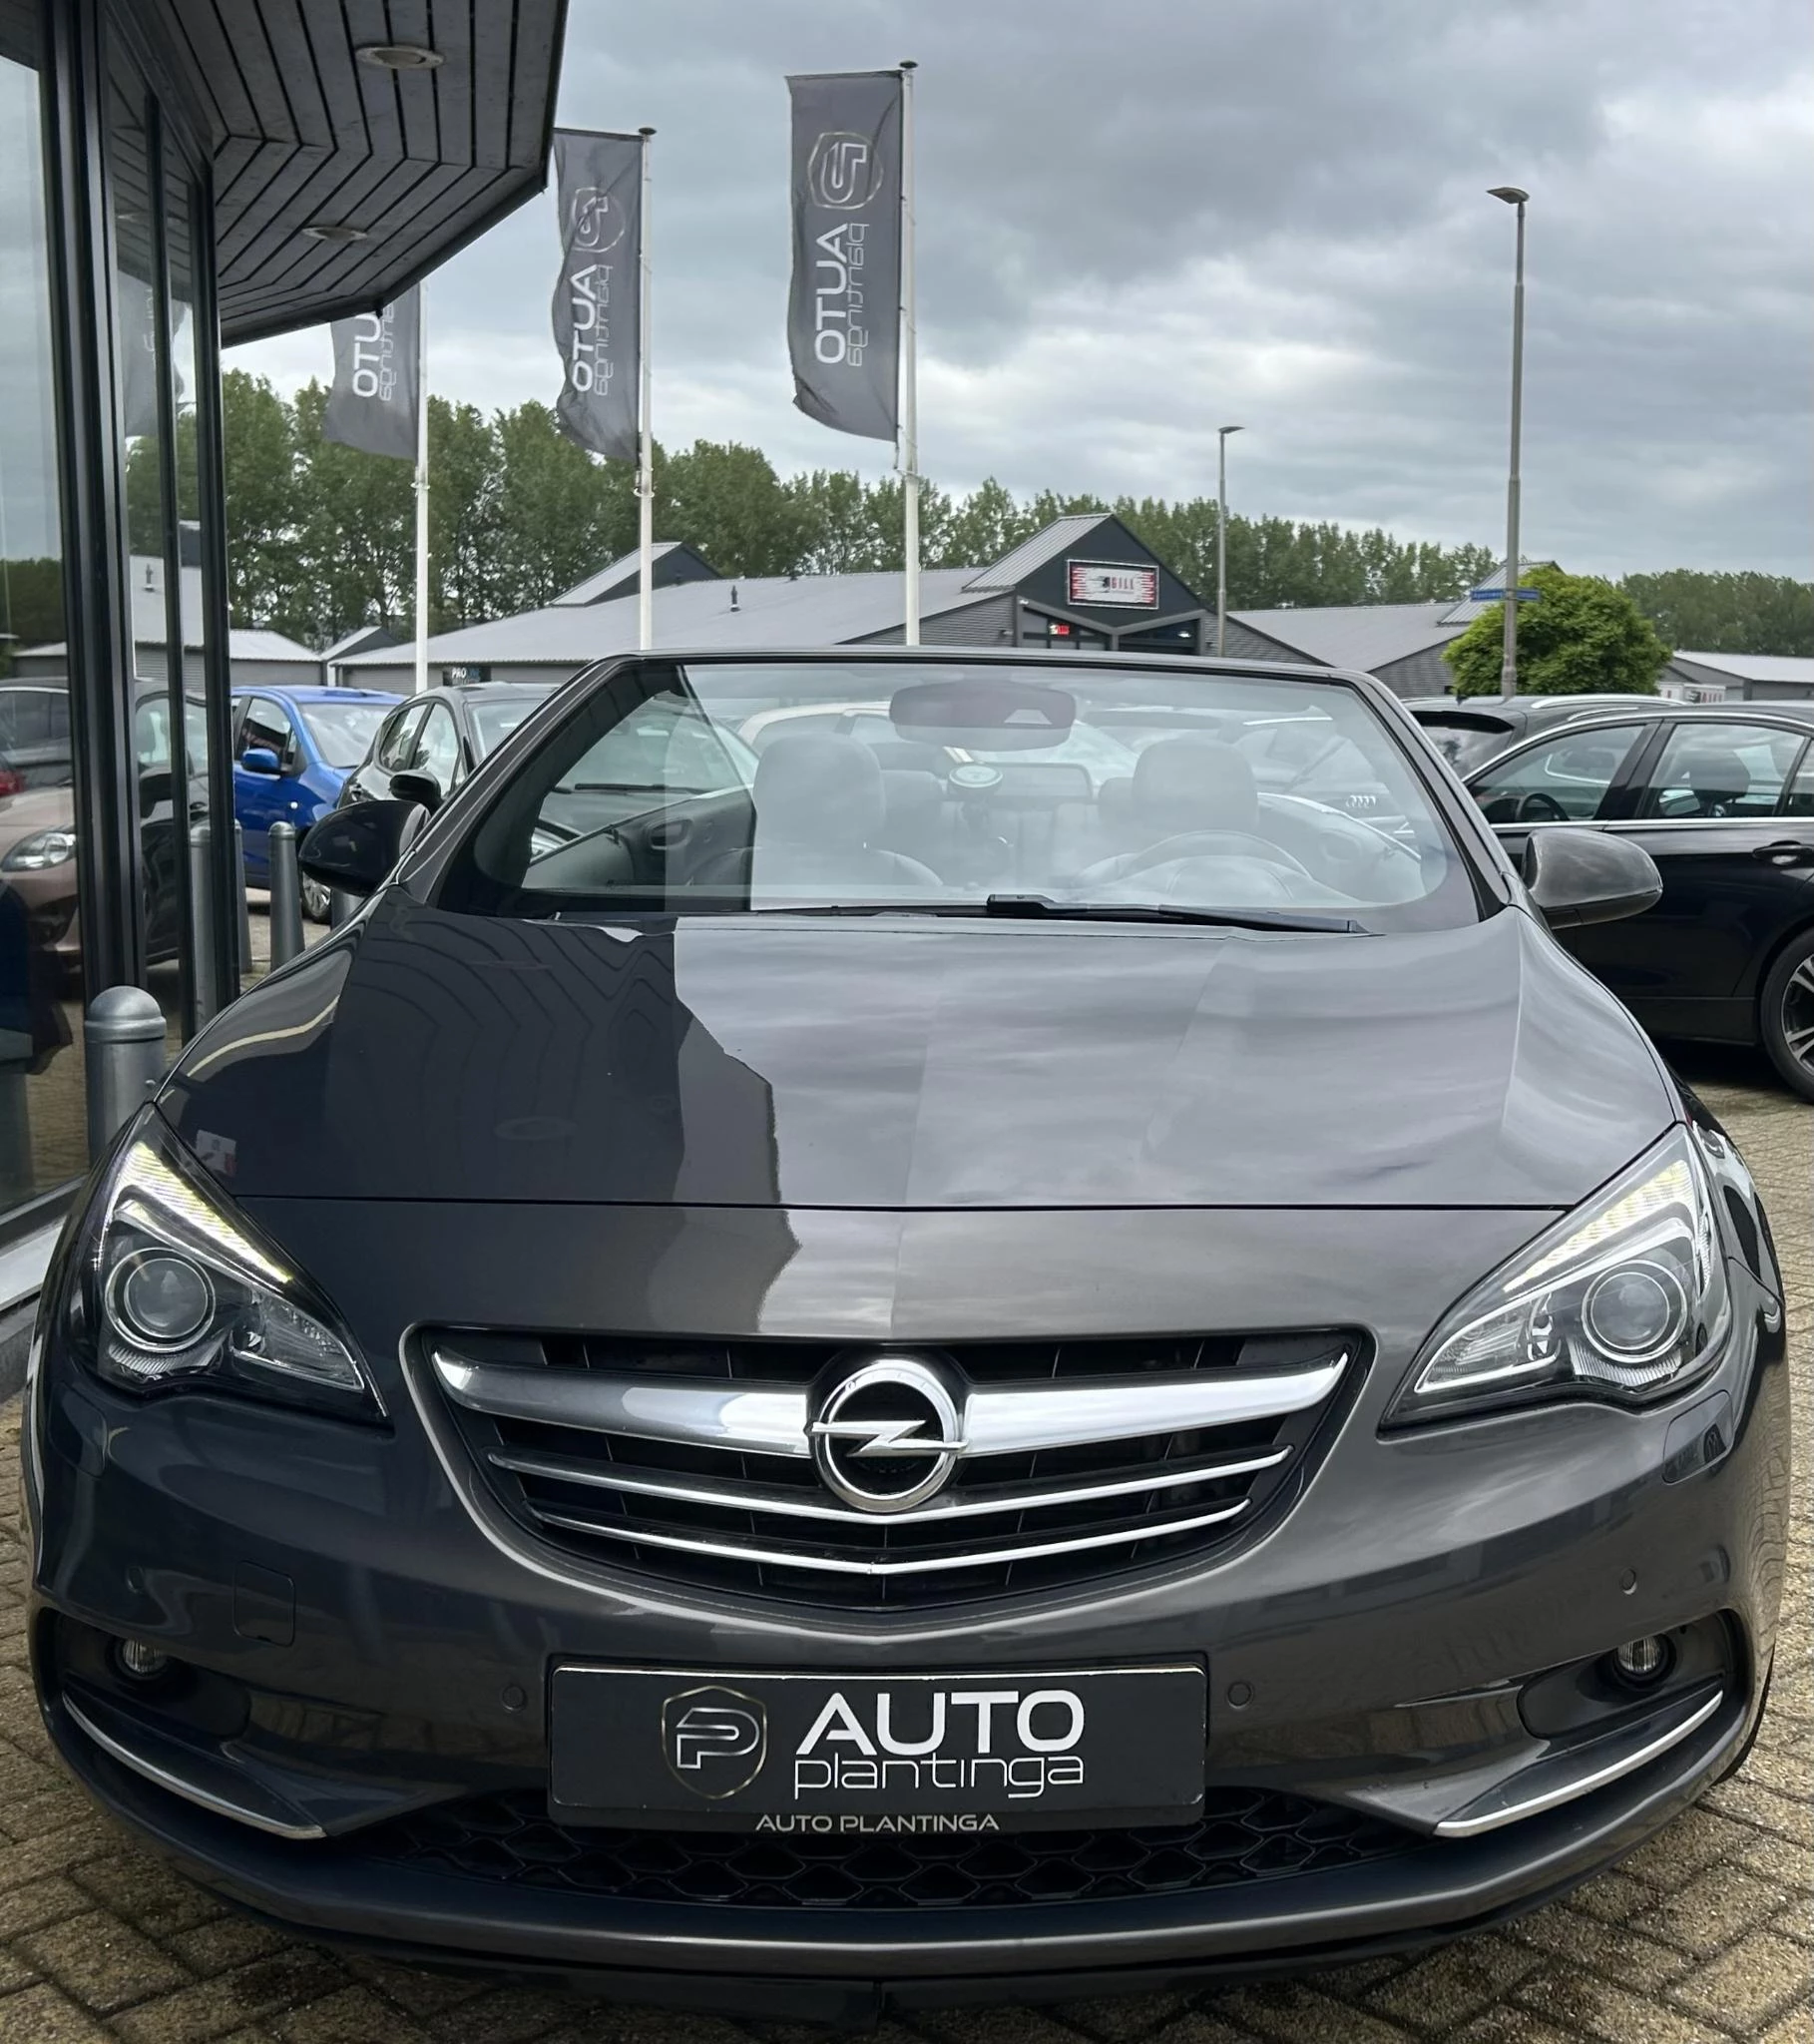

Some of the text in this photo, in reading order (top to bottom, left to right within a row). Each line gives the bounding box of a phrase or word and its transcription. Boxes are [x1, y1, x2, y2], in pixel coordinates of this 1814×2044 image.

[795, 1690, 1085, 1756] AUTO
[794, 1752, 1084, 1799] plantinga
[755, 1813, 1000, 1832] AUTO PLANTINGA
